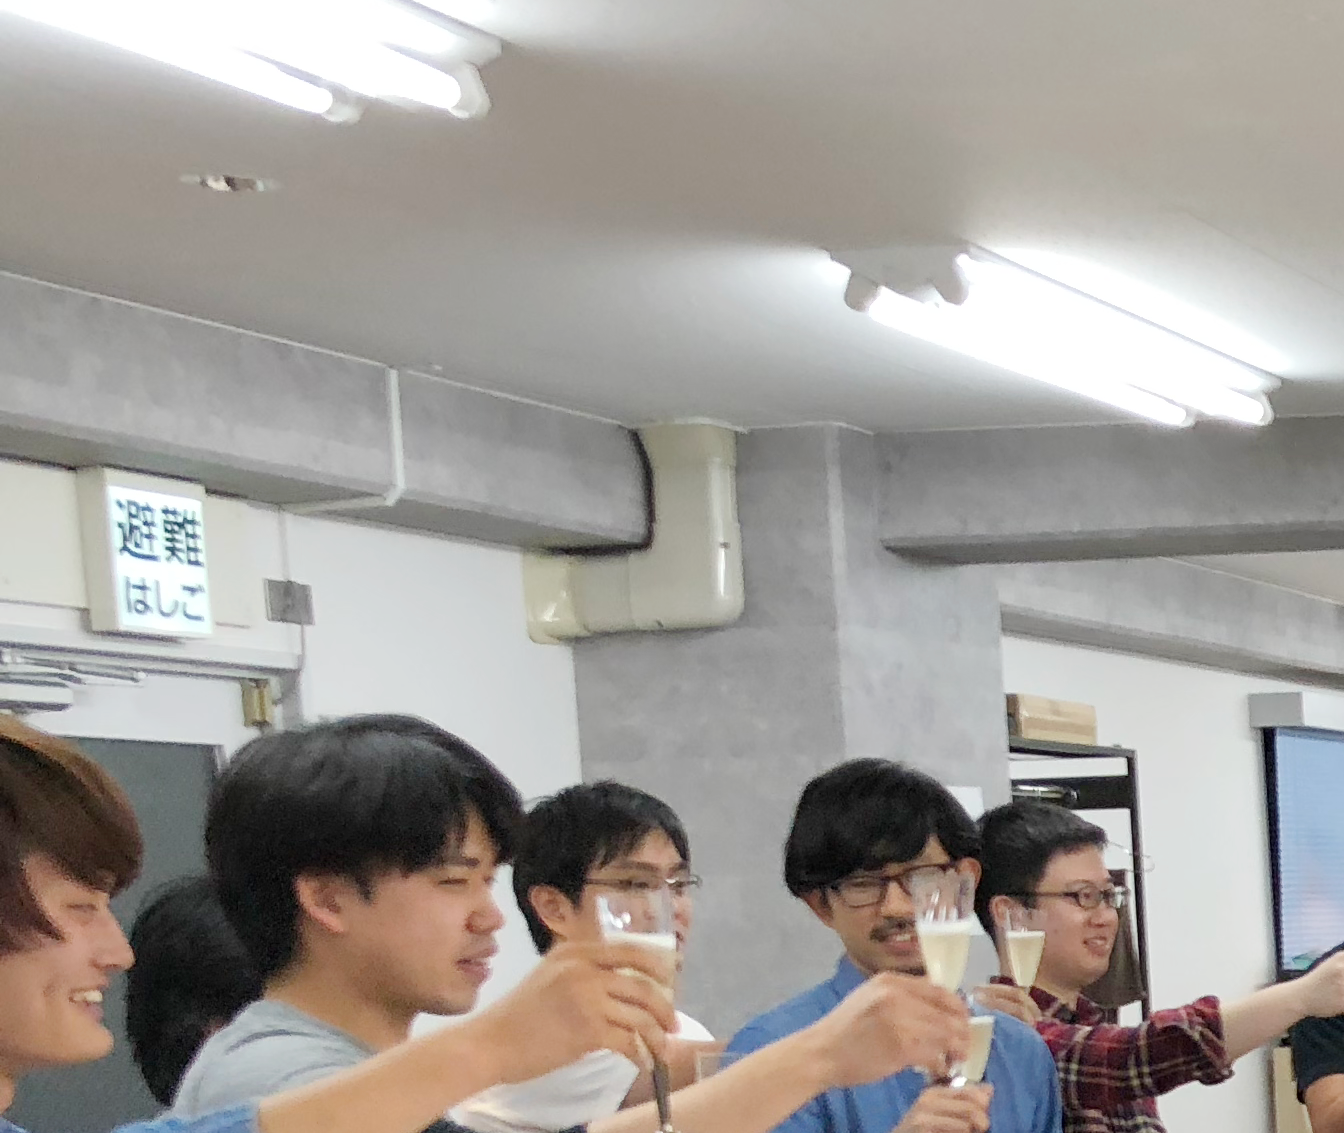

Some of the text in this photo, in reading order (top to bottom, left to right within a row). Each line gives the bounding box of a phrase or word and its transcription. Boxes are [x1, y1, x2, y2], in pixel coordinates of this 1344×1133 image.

[115, 499, 205, 567] 避難
[124, 576, 205, 621] はしご
